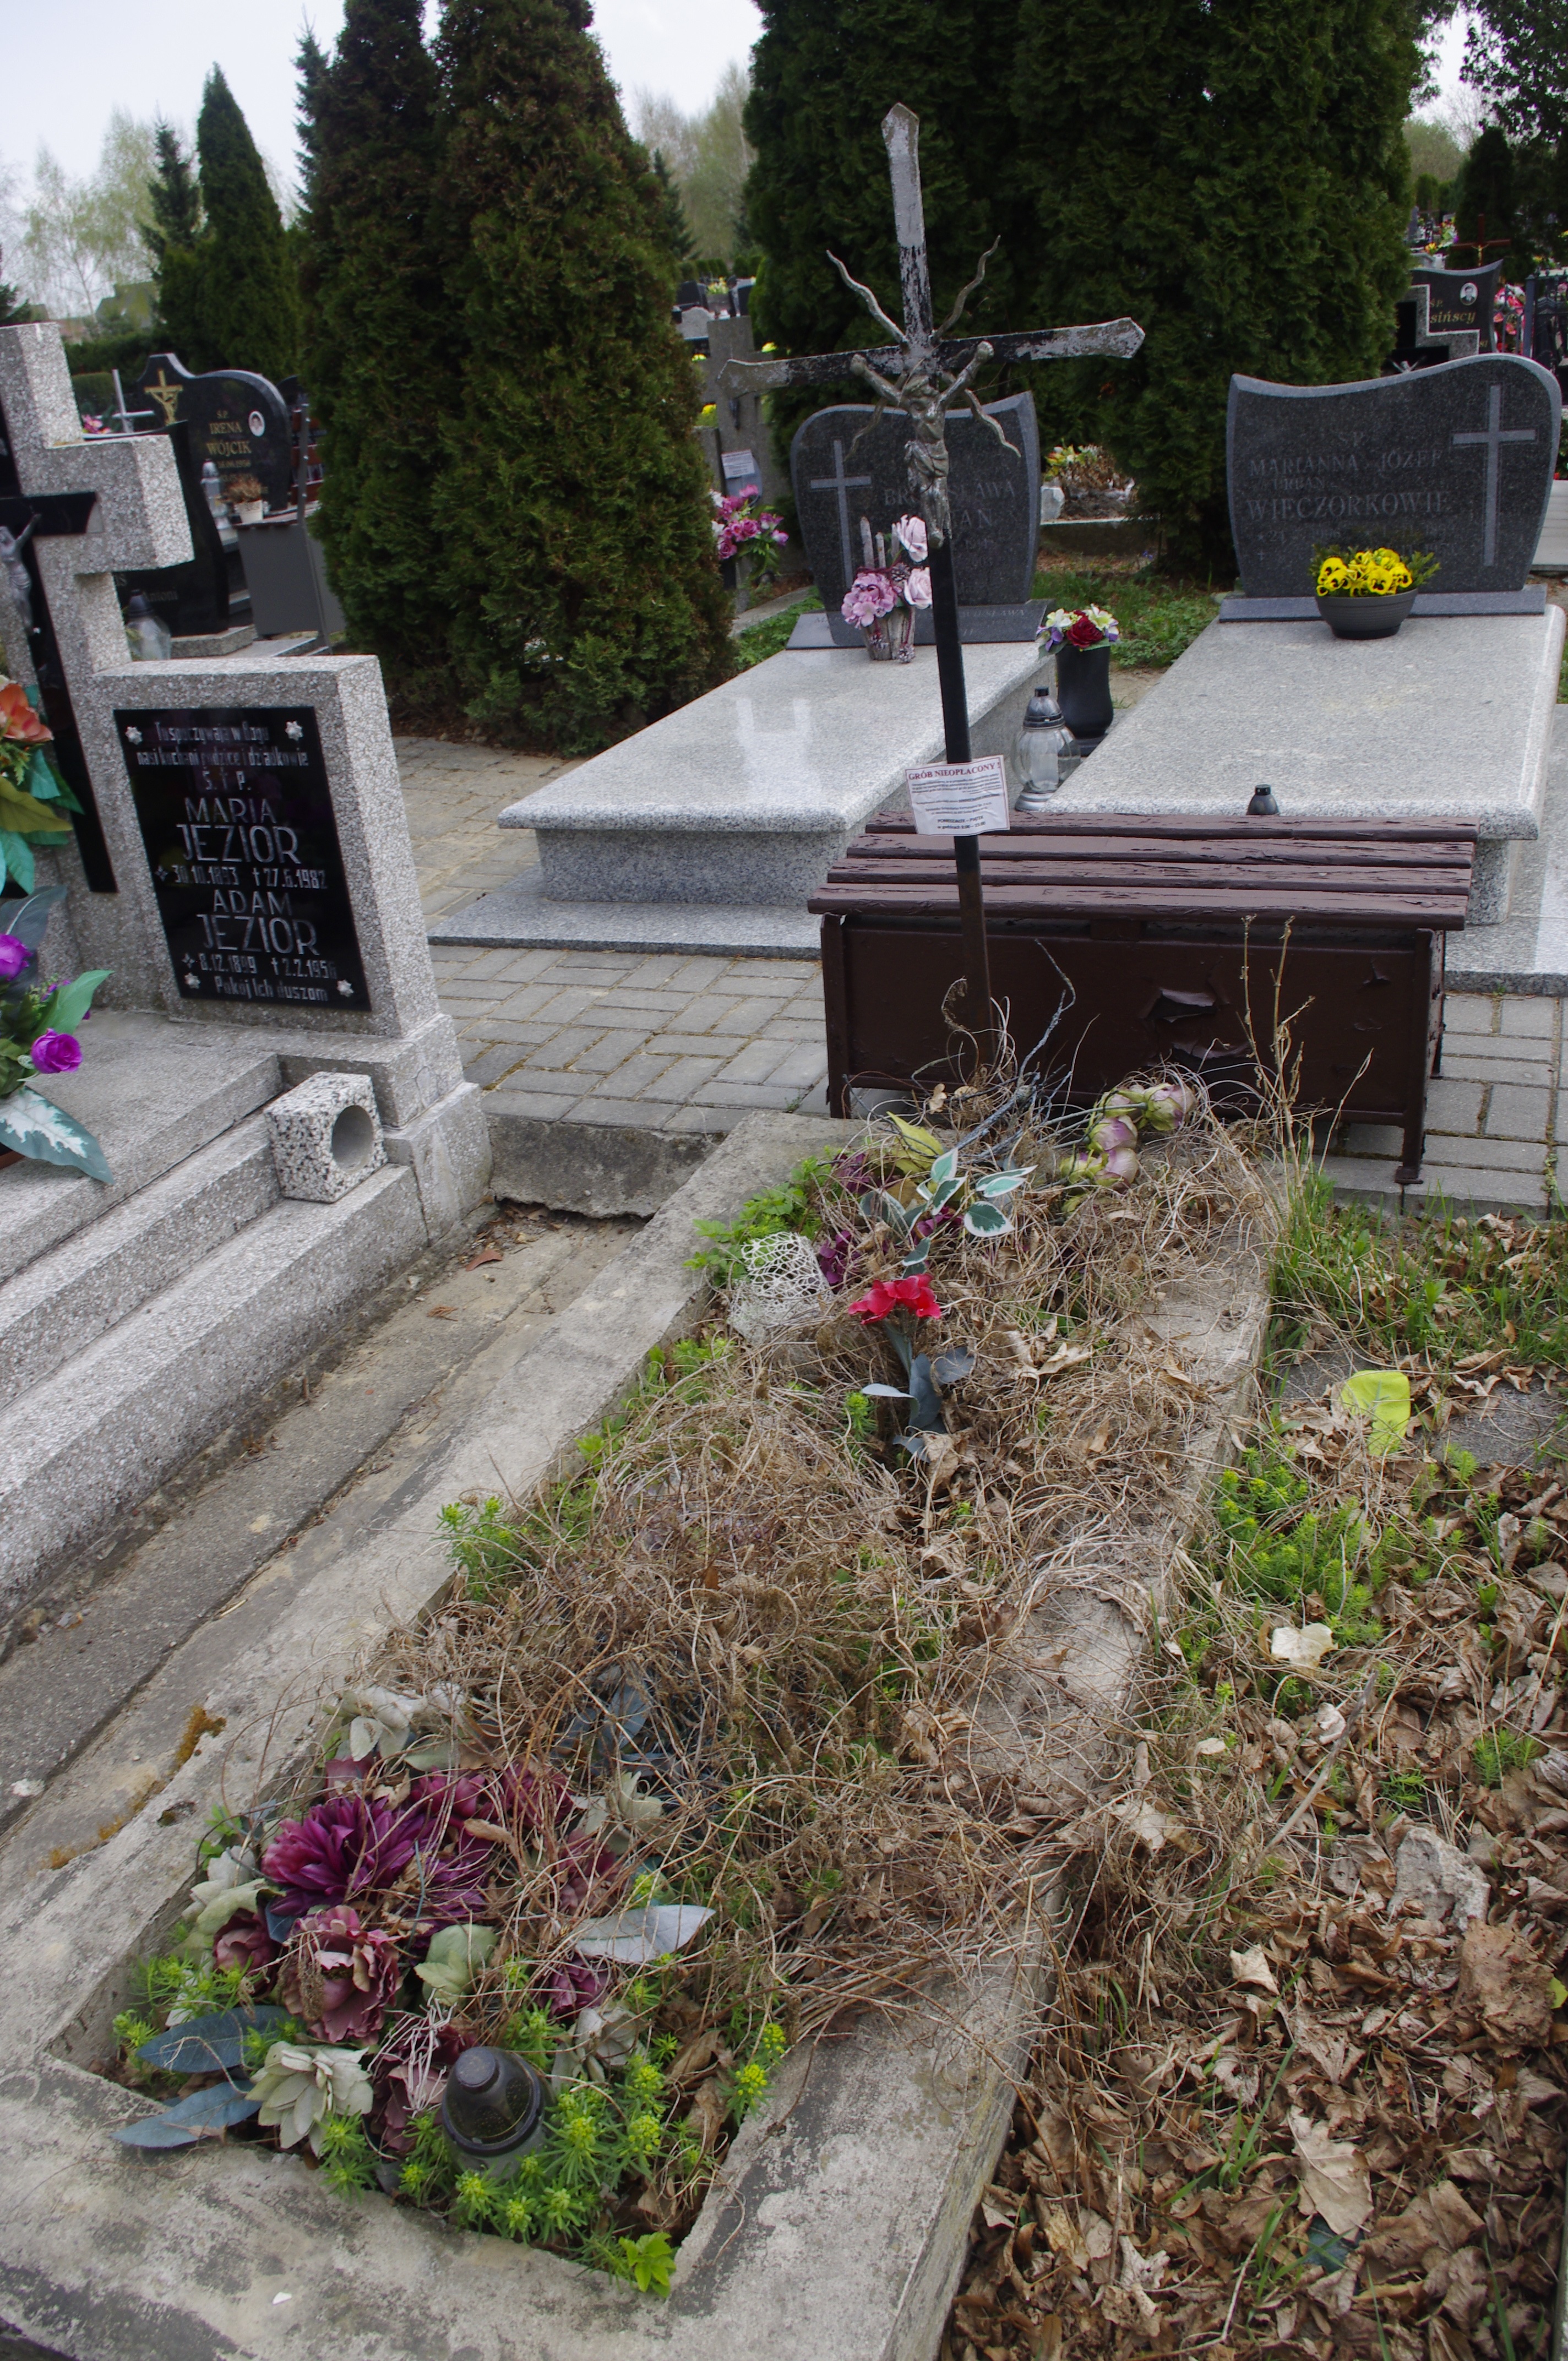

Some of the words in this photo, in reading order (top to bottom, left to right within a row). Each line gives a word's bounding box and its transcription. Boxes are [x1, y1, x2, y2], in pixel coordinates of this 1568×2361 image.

[209, 421, 242, 434] IRENA
[206, 439, 252, 457] WÓJCIK
[1249, 454, 1359, 476] MARIANNA
[908, 770, 933, 780] GRÓB
[934, 762, 995, 777] NIEOPŁACONY
[184, 797, 276, 824] MARIA
[176, 824, 302, 864] JEZIOR
[213, 889, 293, 916] ADAM
[196, 913, 321, 955] JEZIOR
